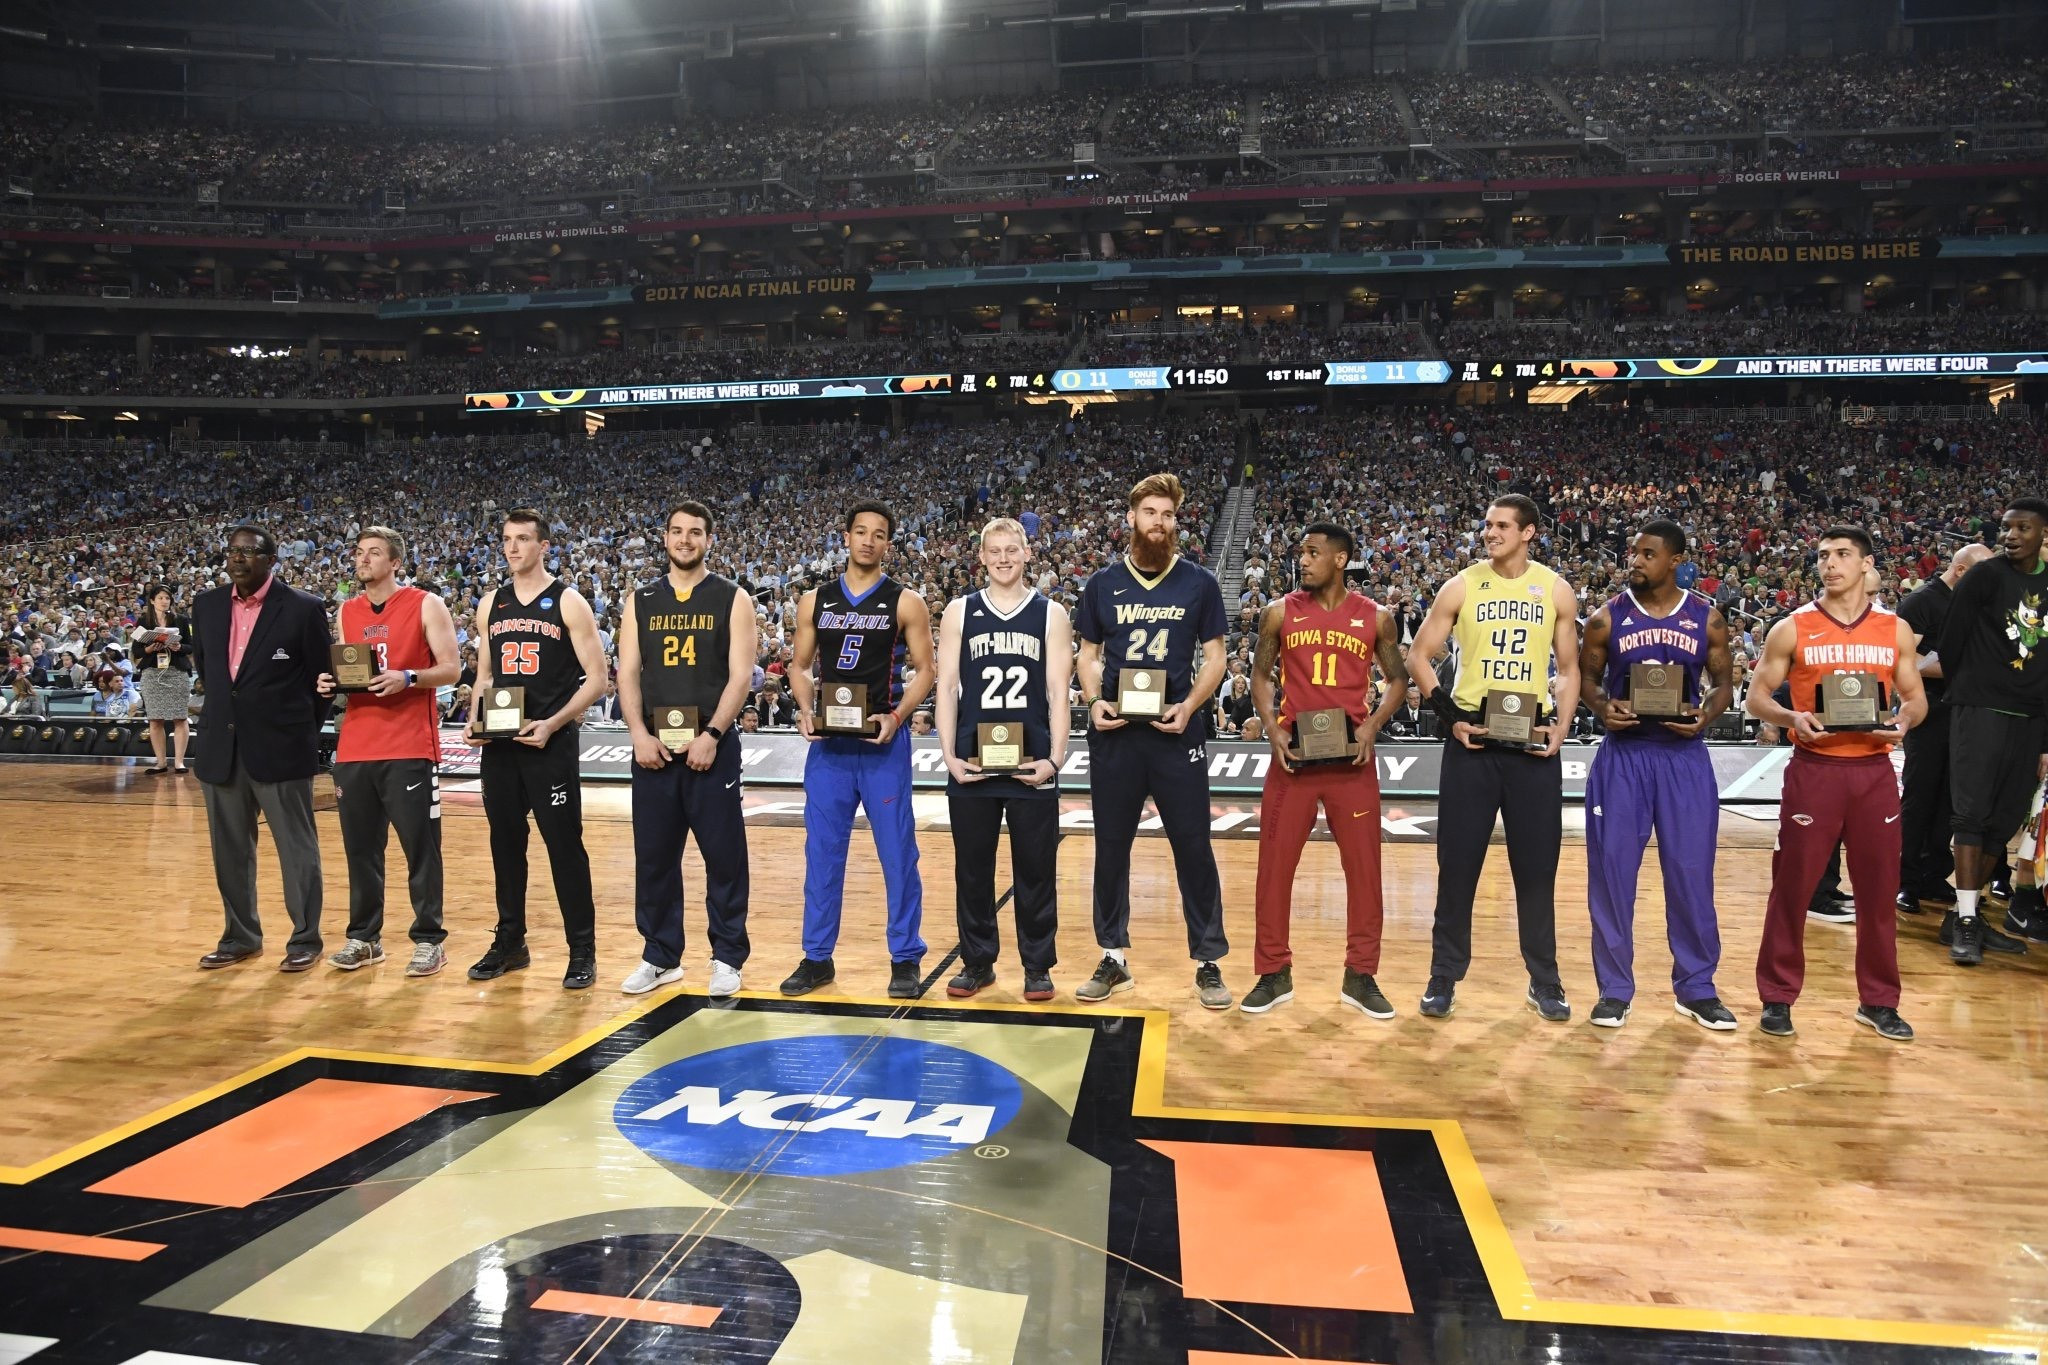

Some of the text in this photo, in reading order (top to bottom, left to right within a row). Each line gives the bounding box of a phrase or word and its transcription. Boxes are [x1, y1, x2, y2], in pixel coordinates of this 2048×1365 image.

[1735, 173, 1781, 183] ROGER
[1786, 170, 1840, 181] WEHRLI
[1107, 195, 1130, 205] PAT
[1133, 192, 1188, 204] TILLMAN
[495, 225, 628, 242] CHARLES W. BIDWILL, SR.
[1681, 241, 1921, 264] THE ROAD ENDS HERE
[645, 278, 857, 302] 2017 NCAA FINAL FOUR
[1128, 371, 1157, 379] BONUS
[1266, 369, 1322, 381] 1ST Half
[1336, 365, 1366, 373] BONUS
[1385, 365, 1406, 380] 11
[1465, 363, 1478, 372] TM
[1491, 363, 1503, 377] 4
[1516, 363, 1554, 376] TOL 4
[1736, 357, 1989, 374] AND THEN THERE WERE FOUR
[963, 374, 976, 383] TM
[985, 375, 997, 388] 4
[1009, 374, 1044, 387] TOL 4
[1089, 371, 1108, 387] 11
[1173, 368, 1229, 385] 11:50
[600, 383, 800, 403] AND THEN THERE WERE FOUR
[1113, 603, 1185, 625] Wingate
[1477, 600, 1544, 625] GEORGIA
[490, 618, 561, 640] PRINCETON
[649, 614, 714, 631] GRACELAND
[364, 625, 389, 640] NORTH
[1491, 628, 1527, 654] 42
[1619, 628, 1699, 656] NORTHWESTERN
[664, 635, 696, 666] 24
[836, 634, 864, 670] 5
[1125, 628, 1170, 661] 24
[1286, 629, 1368, 660] IOWA STATE
[371, 643, 388, 670] 3
[501, 642, 540, 675] 25
[1804, 644, 1894, 667] RIVER HAWKS
[1311, 652, 1337, 687] 11
[1481, 659, 1532, 681] TECH
[981, 666, 1028, 709] 22
[1188, 744, 1205, 763] 24
[550, 791, 567, 806] 25
[632, 1086, 996, 1144] NCAA
